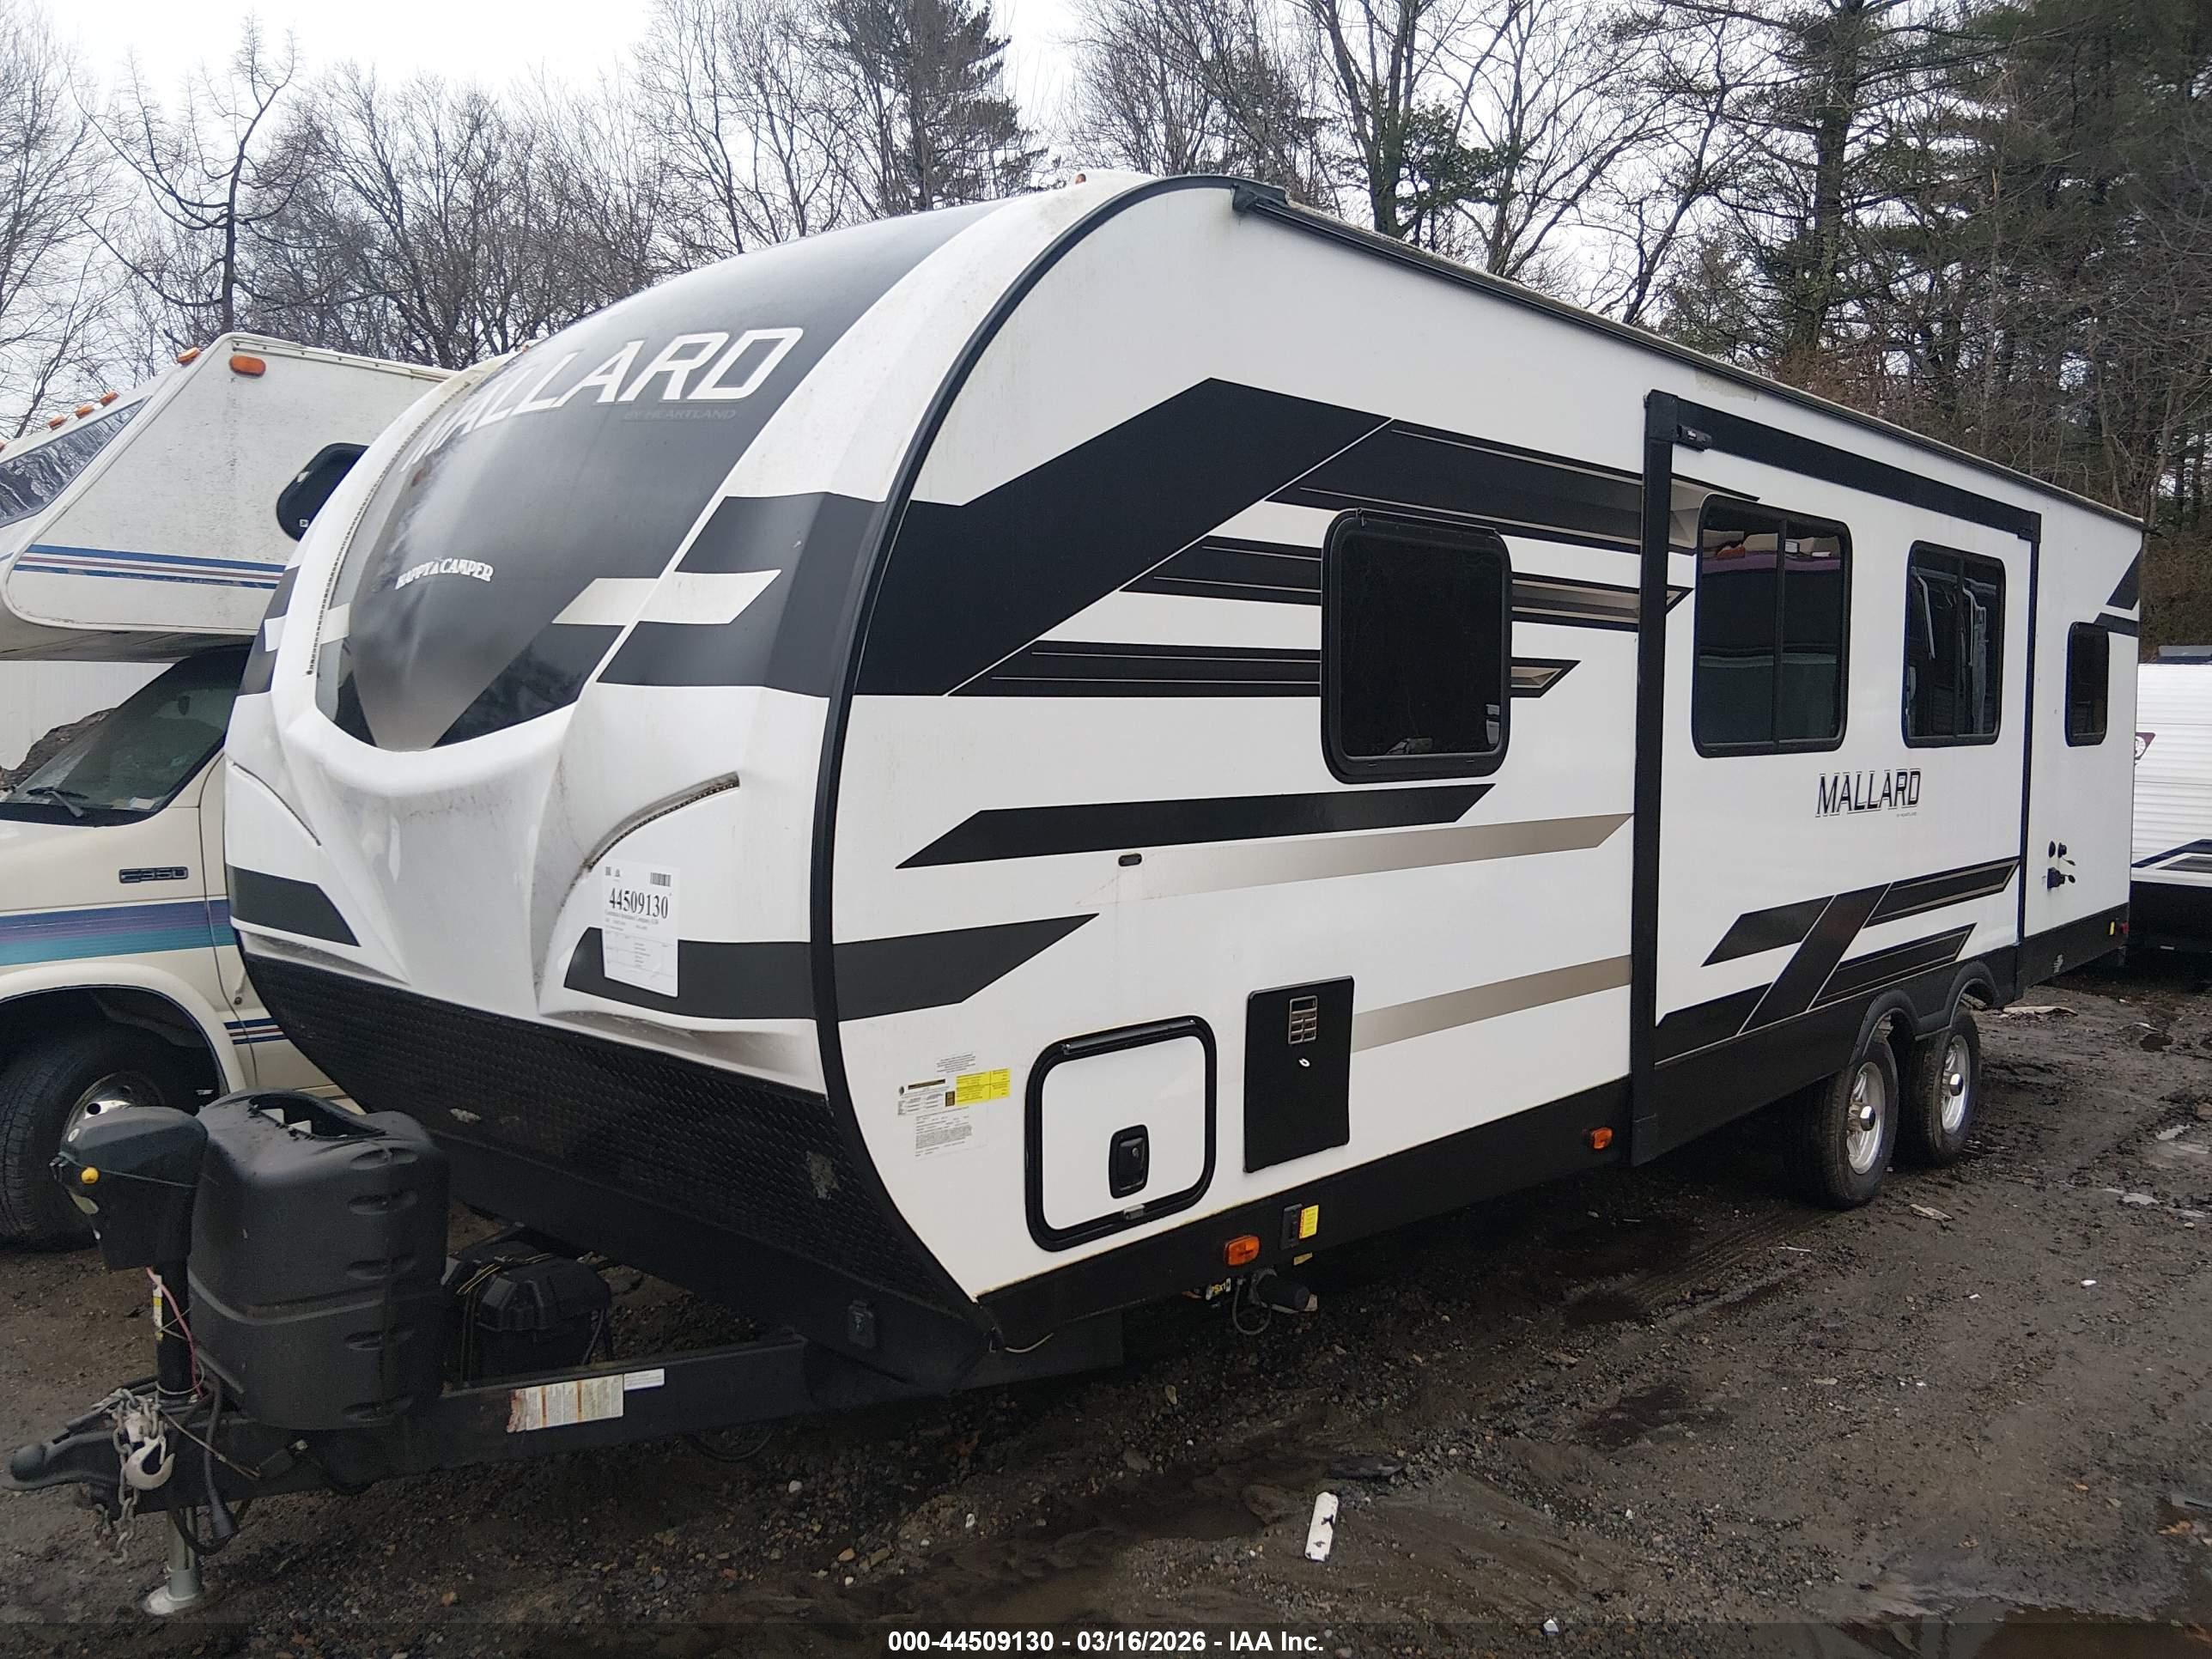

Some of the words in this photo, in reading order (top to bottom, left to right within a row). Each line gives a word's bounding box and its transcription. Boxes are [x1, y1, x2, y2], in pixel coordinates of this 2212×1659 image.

[400, 327, 804, 471] MALLARD
[440, 558, 494, 582] CAMPER
[1815, 769, 1921, 817] MALLARD
[609, 888, 668, 919] 44509130
